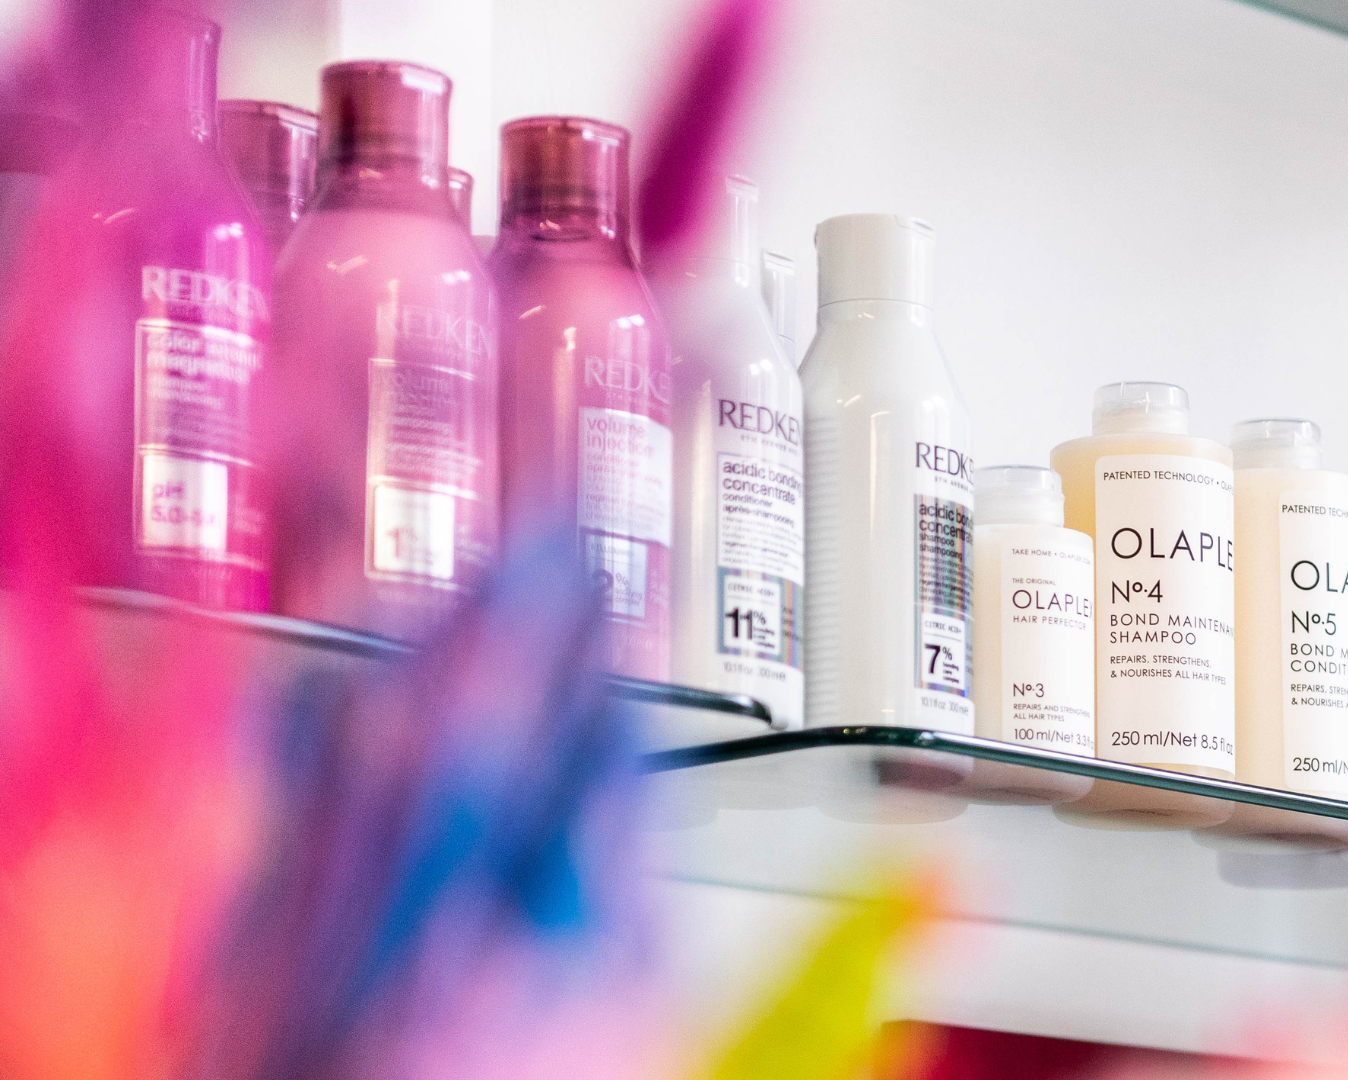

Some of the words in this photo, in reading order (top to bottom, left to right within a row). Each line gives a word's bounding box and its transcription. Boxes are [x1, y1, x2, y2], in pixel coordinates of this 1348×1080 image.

[723, 460, 765, 479] acidic
[1103, 471, 1151, 481] PATENTED
[1154, 471, 1214, 486] TECHNOLOGY
[723, 477, 796, 506] concentrate
[723, 492, 773, 508] conditioner
[919, 502, 954, 521] acidic
[1282, 504, 1326, 515] PATENTED
[1011, 548, 1029, 556] TAKE
[1031, 549, 1052, 557] HOME
[1026, 578, 1056, 586] ORIGINAL
[1013, 615, 1037, 623] HAIR
[1110, 613, 1160, 627] BOND
[1110, 630, 1197, 645] SHAMPOO
[1290, 643, 1335, 657] BOND
[1110, 670, 1118, 678] &
[1120, 669, 1172, 678] NOURISHES
[1175, 670, 1190, 679] ALL
[1193, 672, 1210, 681] HAIR
[1212, 674, 1227, 686] TYPES
[1013, 703, 1042, 711] REPAIRS
[1291, 697, 1298, 705] &
[1300, 697, 1344, 709] NOURISHES
[1047, 714, 1065, 722] TYPES
[1014, 728, 1034, 741] 100
[1111, 731, 1140, 746] 250
[1201, 734, 1218, 751] 8.5
[1293, 757, 1320, 772] 250
